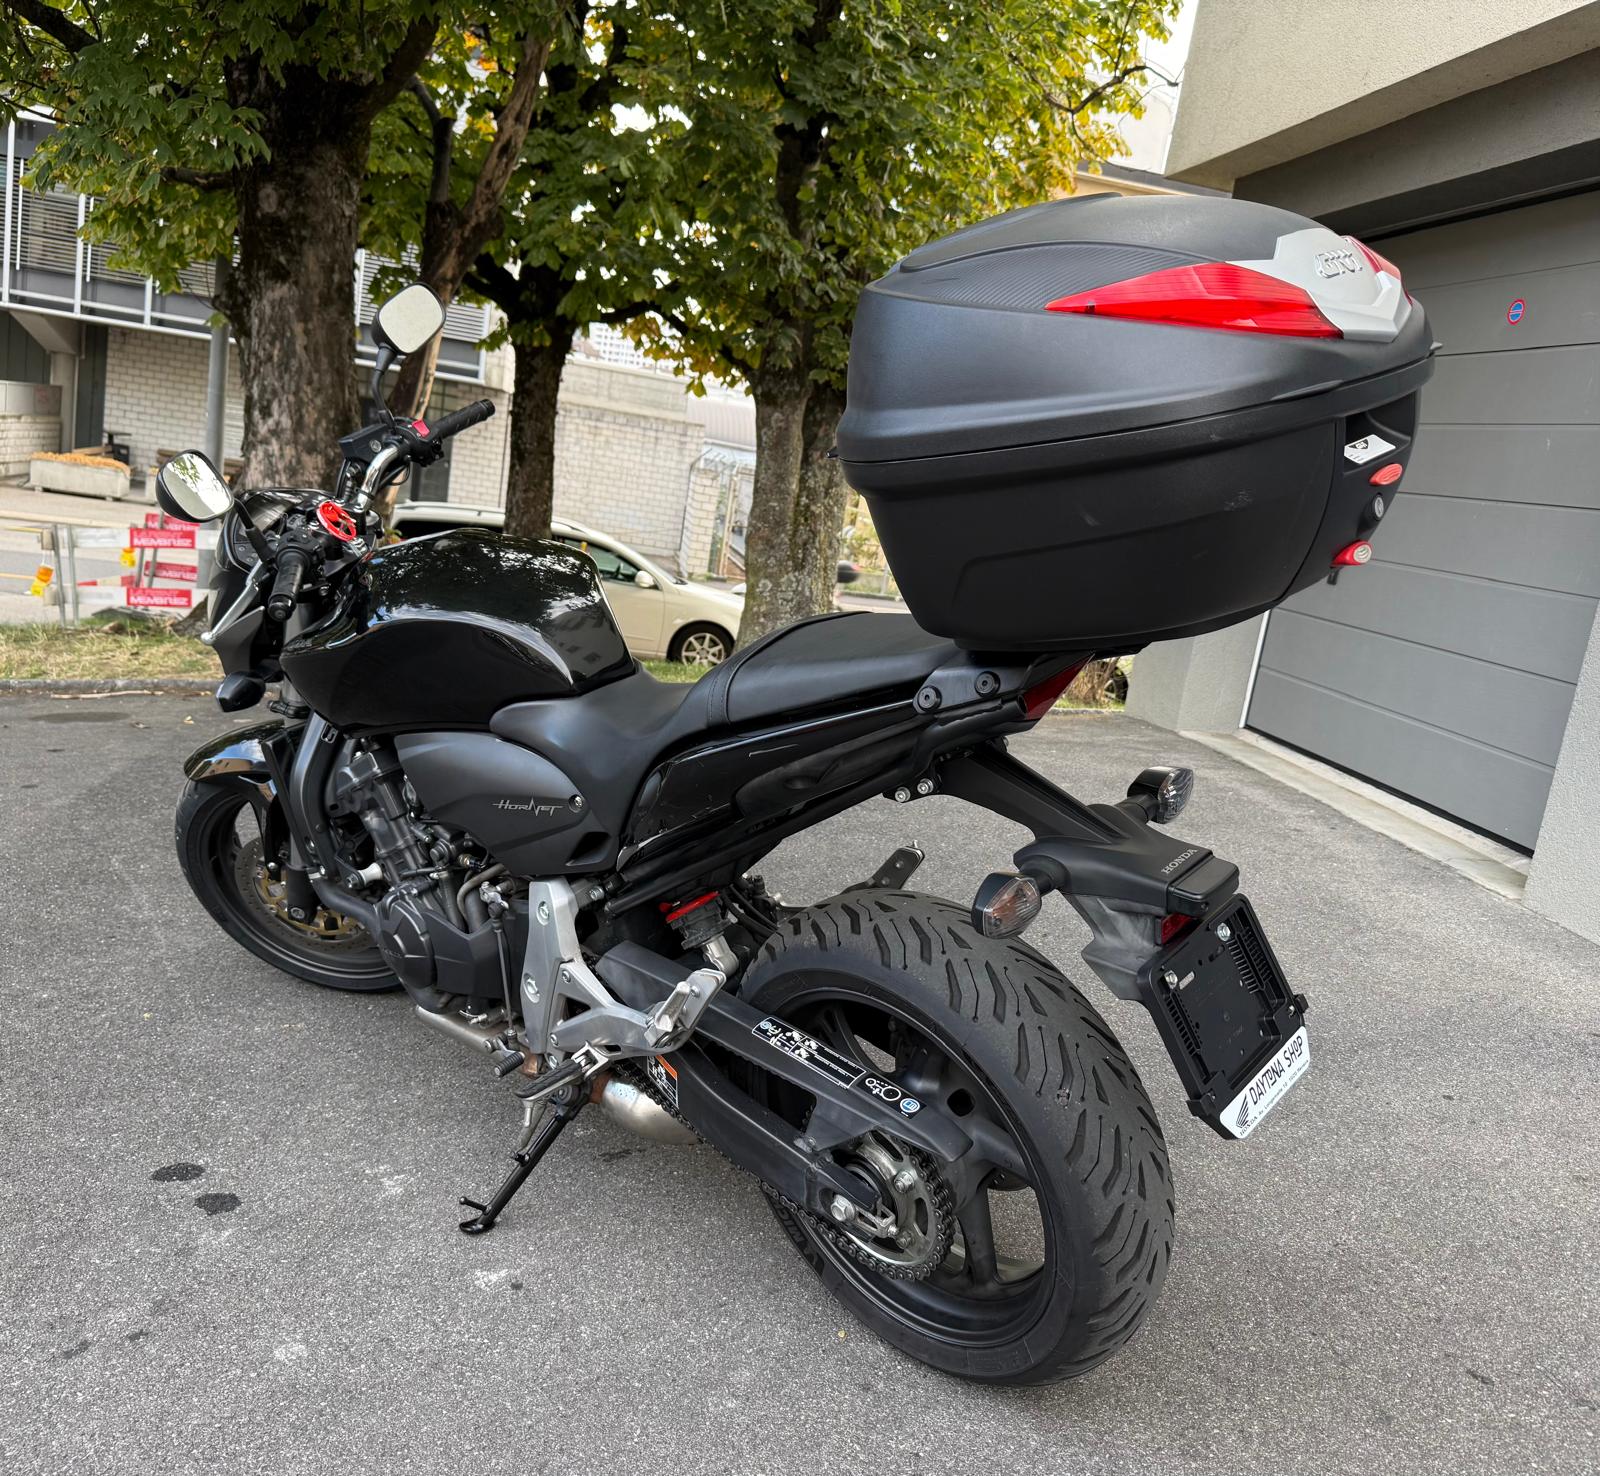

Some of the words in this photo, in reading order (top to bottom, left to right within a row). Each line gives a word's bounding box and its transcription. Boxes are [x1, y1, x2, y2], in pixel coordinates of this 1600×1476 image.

[1161, 848, 1199, 874] HONDA
[1249, 1058, 1285, 1105] DAYTONA
[1283, 1035, 1303, 1068] SHOP
